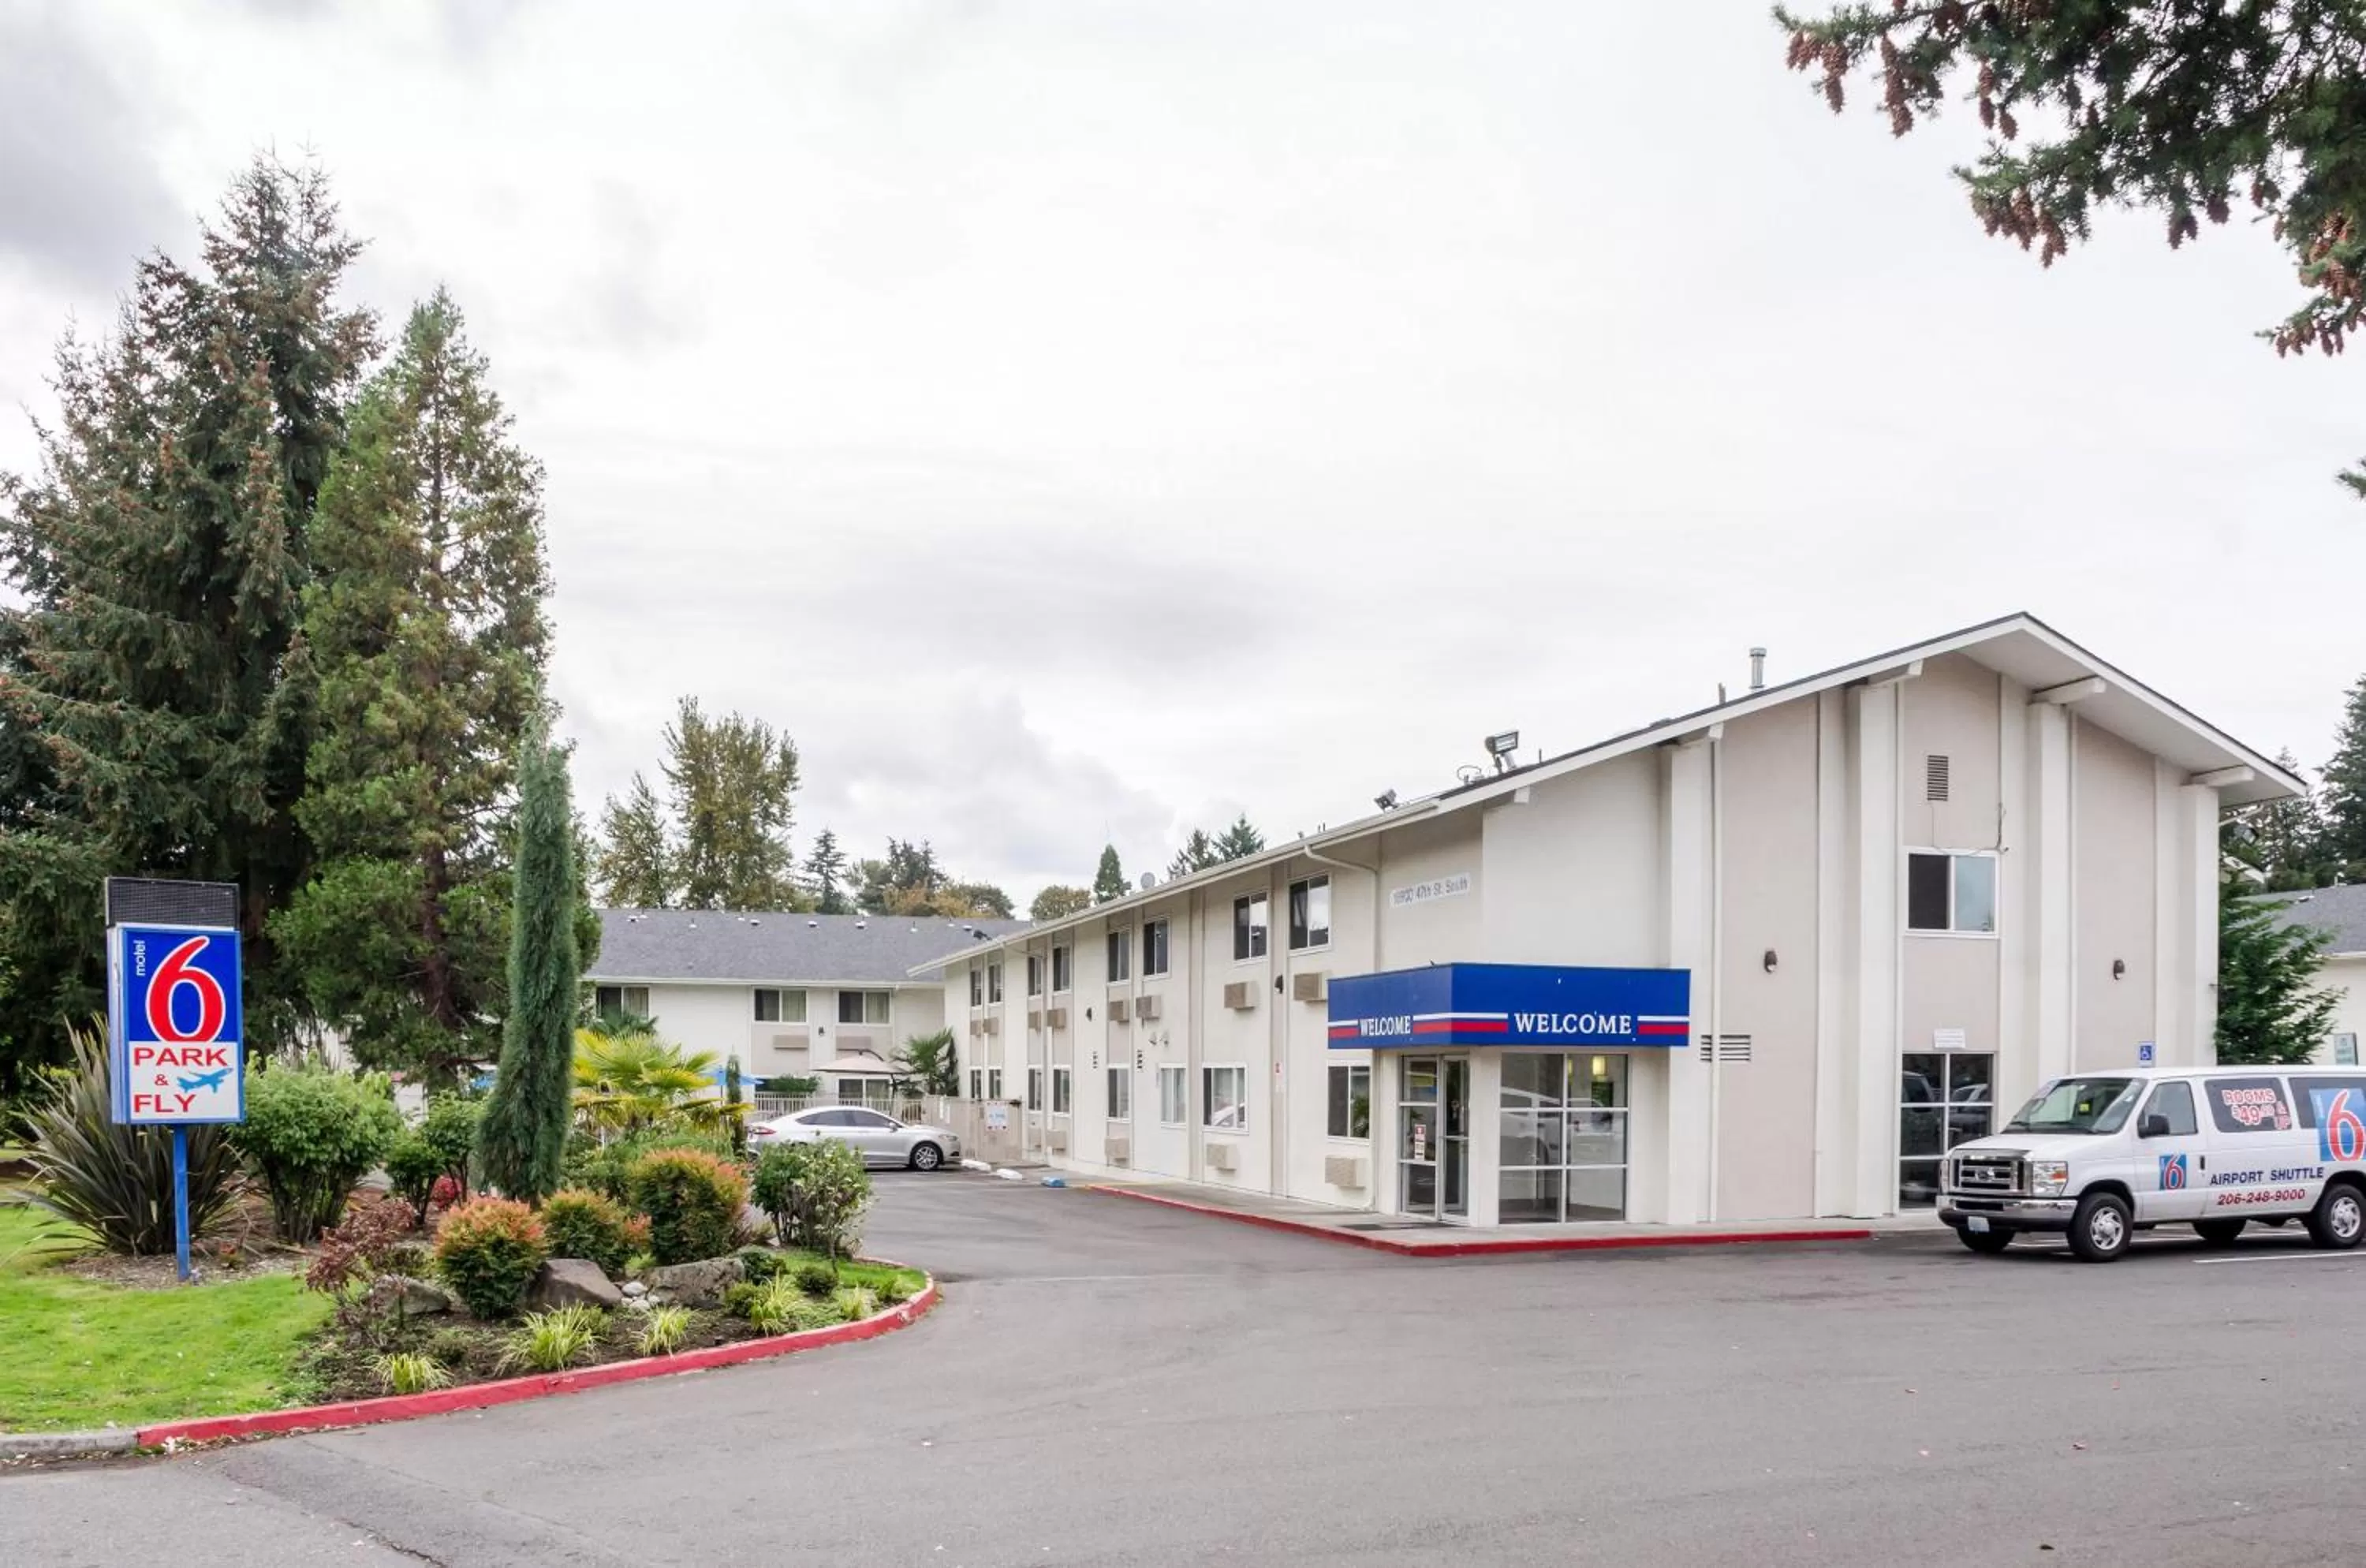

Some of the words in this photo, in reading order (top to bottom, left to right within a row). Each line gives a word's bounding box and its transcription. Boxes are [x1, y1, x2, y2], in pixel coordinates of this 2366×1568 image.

[133, 940, 145, 977] motel
[145, 935, 226, 1043] 6
[1360, 1015, 1411, 1036] WELCOME
[1514, 1012, 1632, 1035] WELCOME
[133, 1047, 228, 1066] PARK
[154, 1073, 169, 1087] &
[133, 1094, 196, 1113] FLY
[2222, 1088, 2276, 1105] ROOMS
[2326, 1088, 2365, 1162] 6
[2163, 1153, 2185, 1190] 6
[2210, 1170, 2264, 1185] AIRPORT
[2270, 1167, 2324, 1182] SHUTTLE
[2217, 1189, 2305, 1205] 206-248-9000
